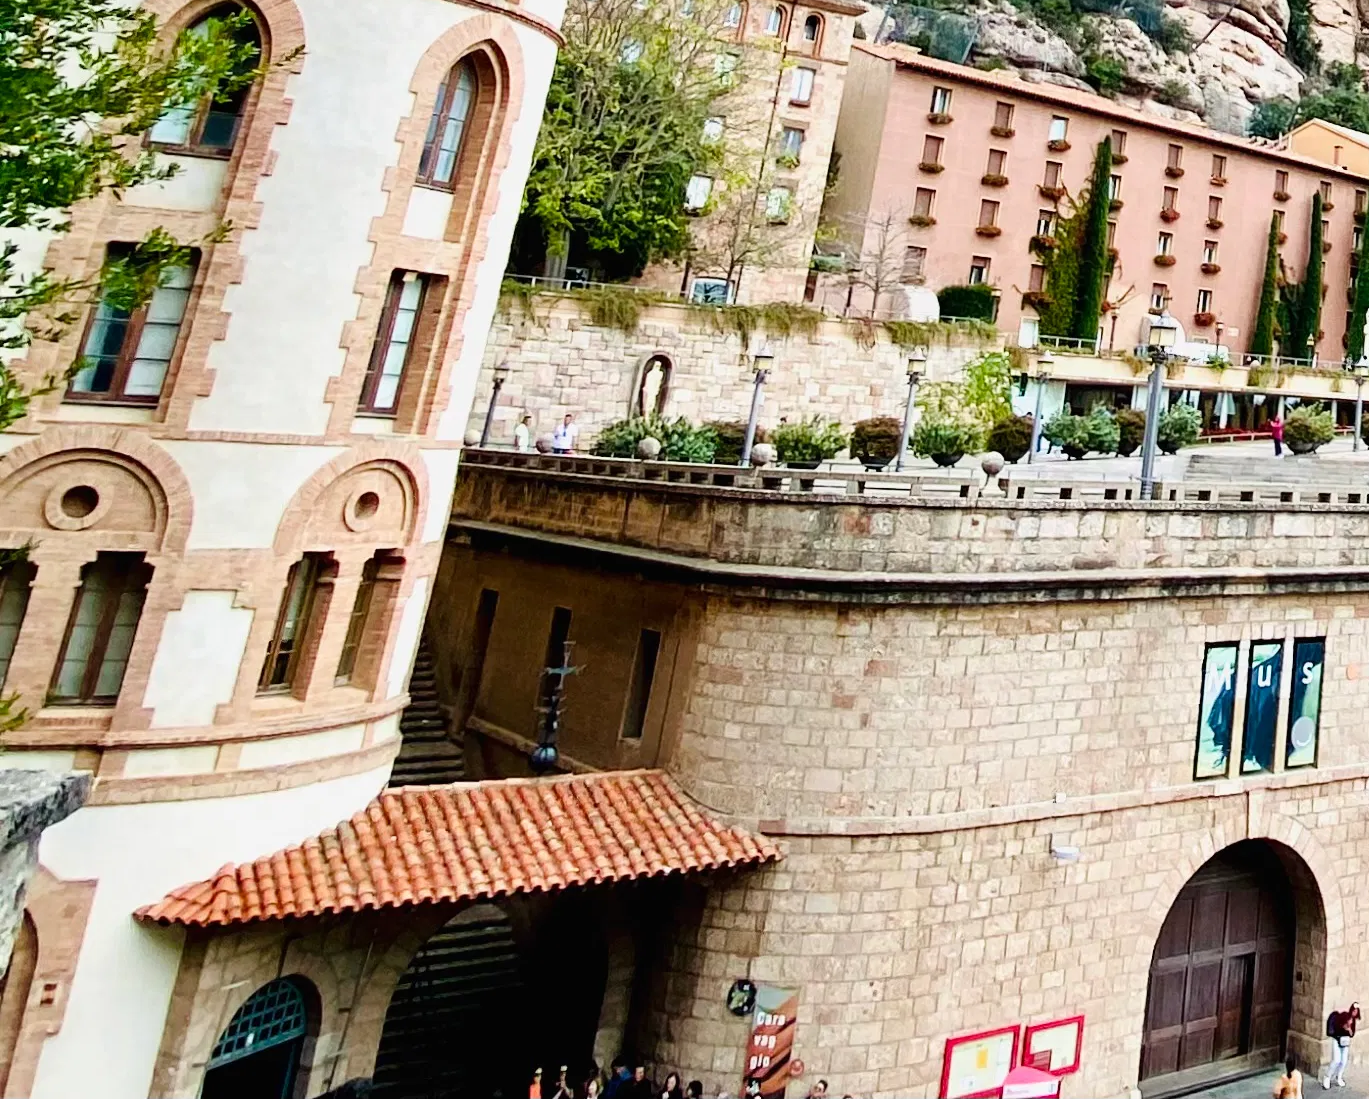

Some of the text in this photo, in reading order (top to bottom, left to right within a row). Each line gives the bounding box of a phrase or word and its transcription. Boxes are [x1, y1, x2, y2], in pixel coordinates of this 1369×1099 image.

[1205, 662, 1314, 691] Mus
[757, 1011, 786, 1026] Cara
[753, 1035, 777, 1049] vag
